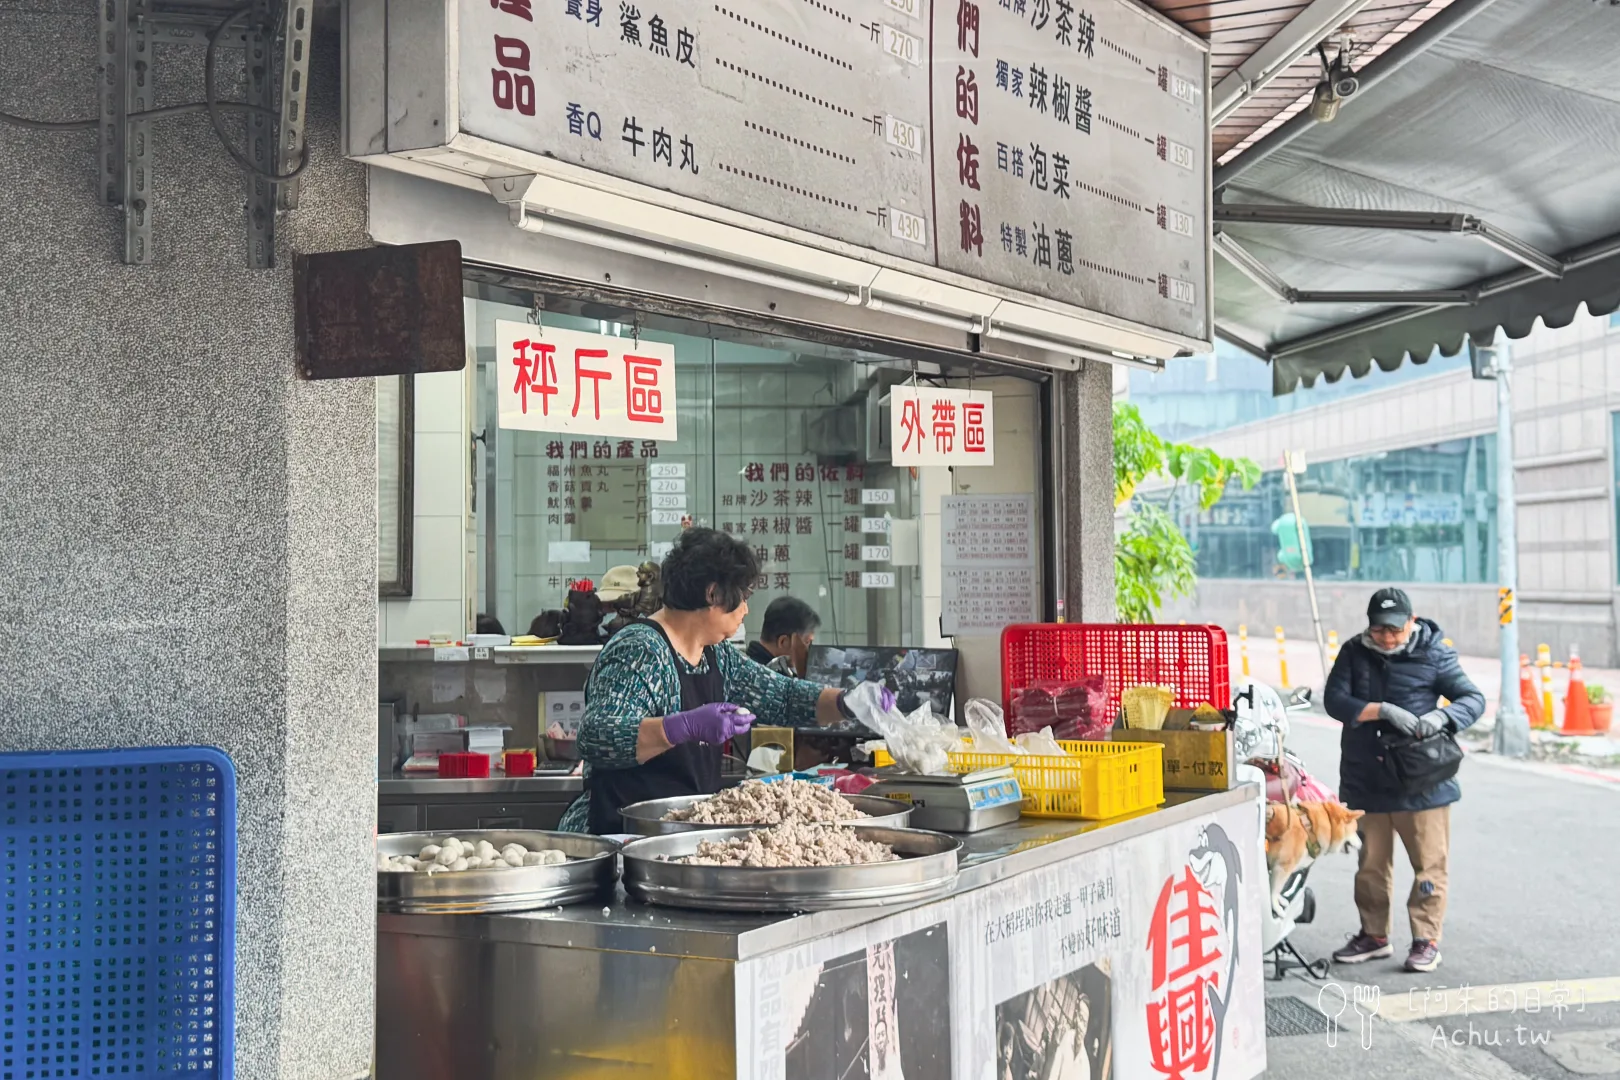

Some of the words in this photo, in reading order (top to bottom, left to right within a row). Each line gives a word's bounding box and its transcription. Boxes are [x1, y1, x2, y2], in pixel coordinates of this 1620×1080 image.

[860, 22, 881, 44] 一斤
[890, 30, 913, 61] 270
[1029, 62, 1093, 135] 辣椒醬
[1174, 147, 1190, 167] 150
[862, 115, 882, 137] 一斤
[892, 122, 915, 150] 430
[566, 101, 602, 141] 香Q
[622, 116, 699, 175] 牛肉丸
[866, 207, 887, 229] 一斤
[897, 216, 920, 241] 430
[996, 141, 1025, 179] 百搭
[1029, 142, 1071, 200] 泡菜
[1000, 222, 1028, 258] 特製
[513, 338, 664, 423] 秤斤區
[901, 399, 985, 454] 外帶區
[545, 440, 658, 459] 我們的產品
[547, 465, 609, 477] 福州魚丸
[658, 467, 678, 476] 250
[658, 481, 678, 491] 270
[658, 498, 679, 507] 290
[750, 489, 813, 507] 沙茶辣
[867, 491, 889, 502] 150
[658, 512, 679, 522] 270
[751, 516, 813, 535] 辣椒醬
[868, 548, 889, 559] 170
[548, 576, 590, 588] 牛肉
[867, 575, 889, 585] 130
[1060, 906, 1121, 959] 不變的好味道
